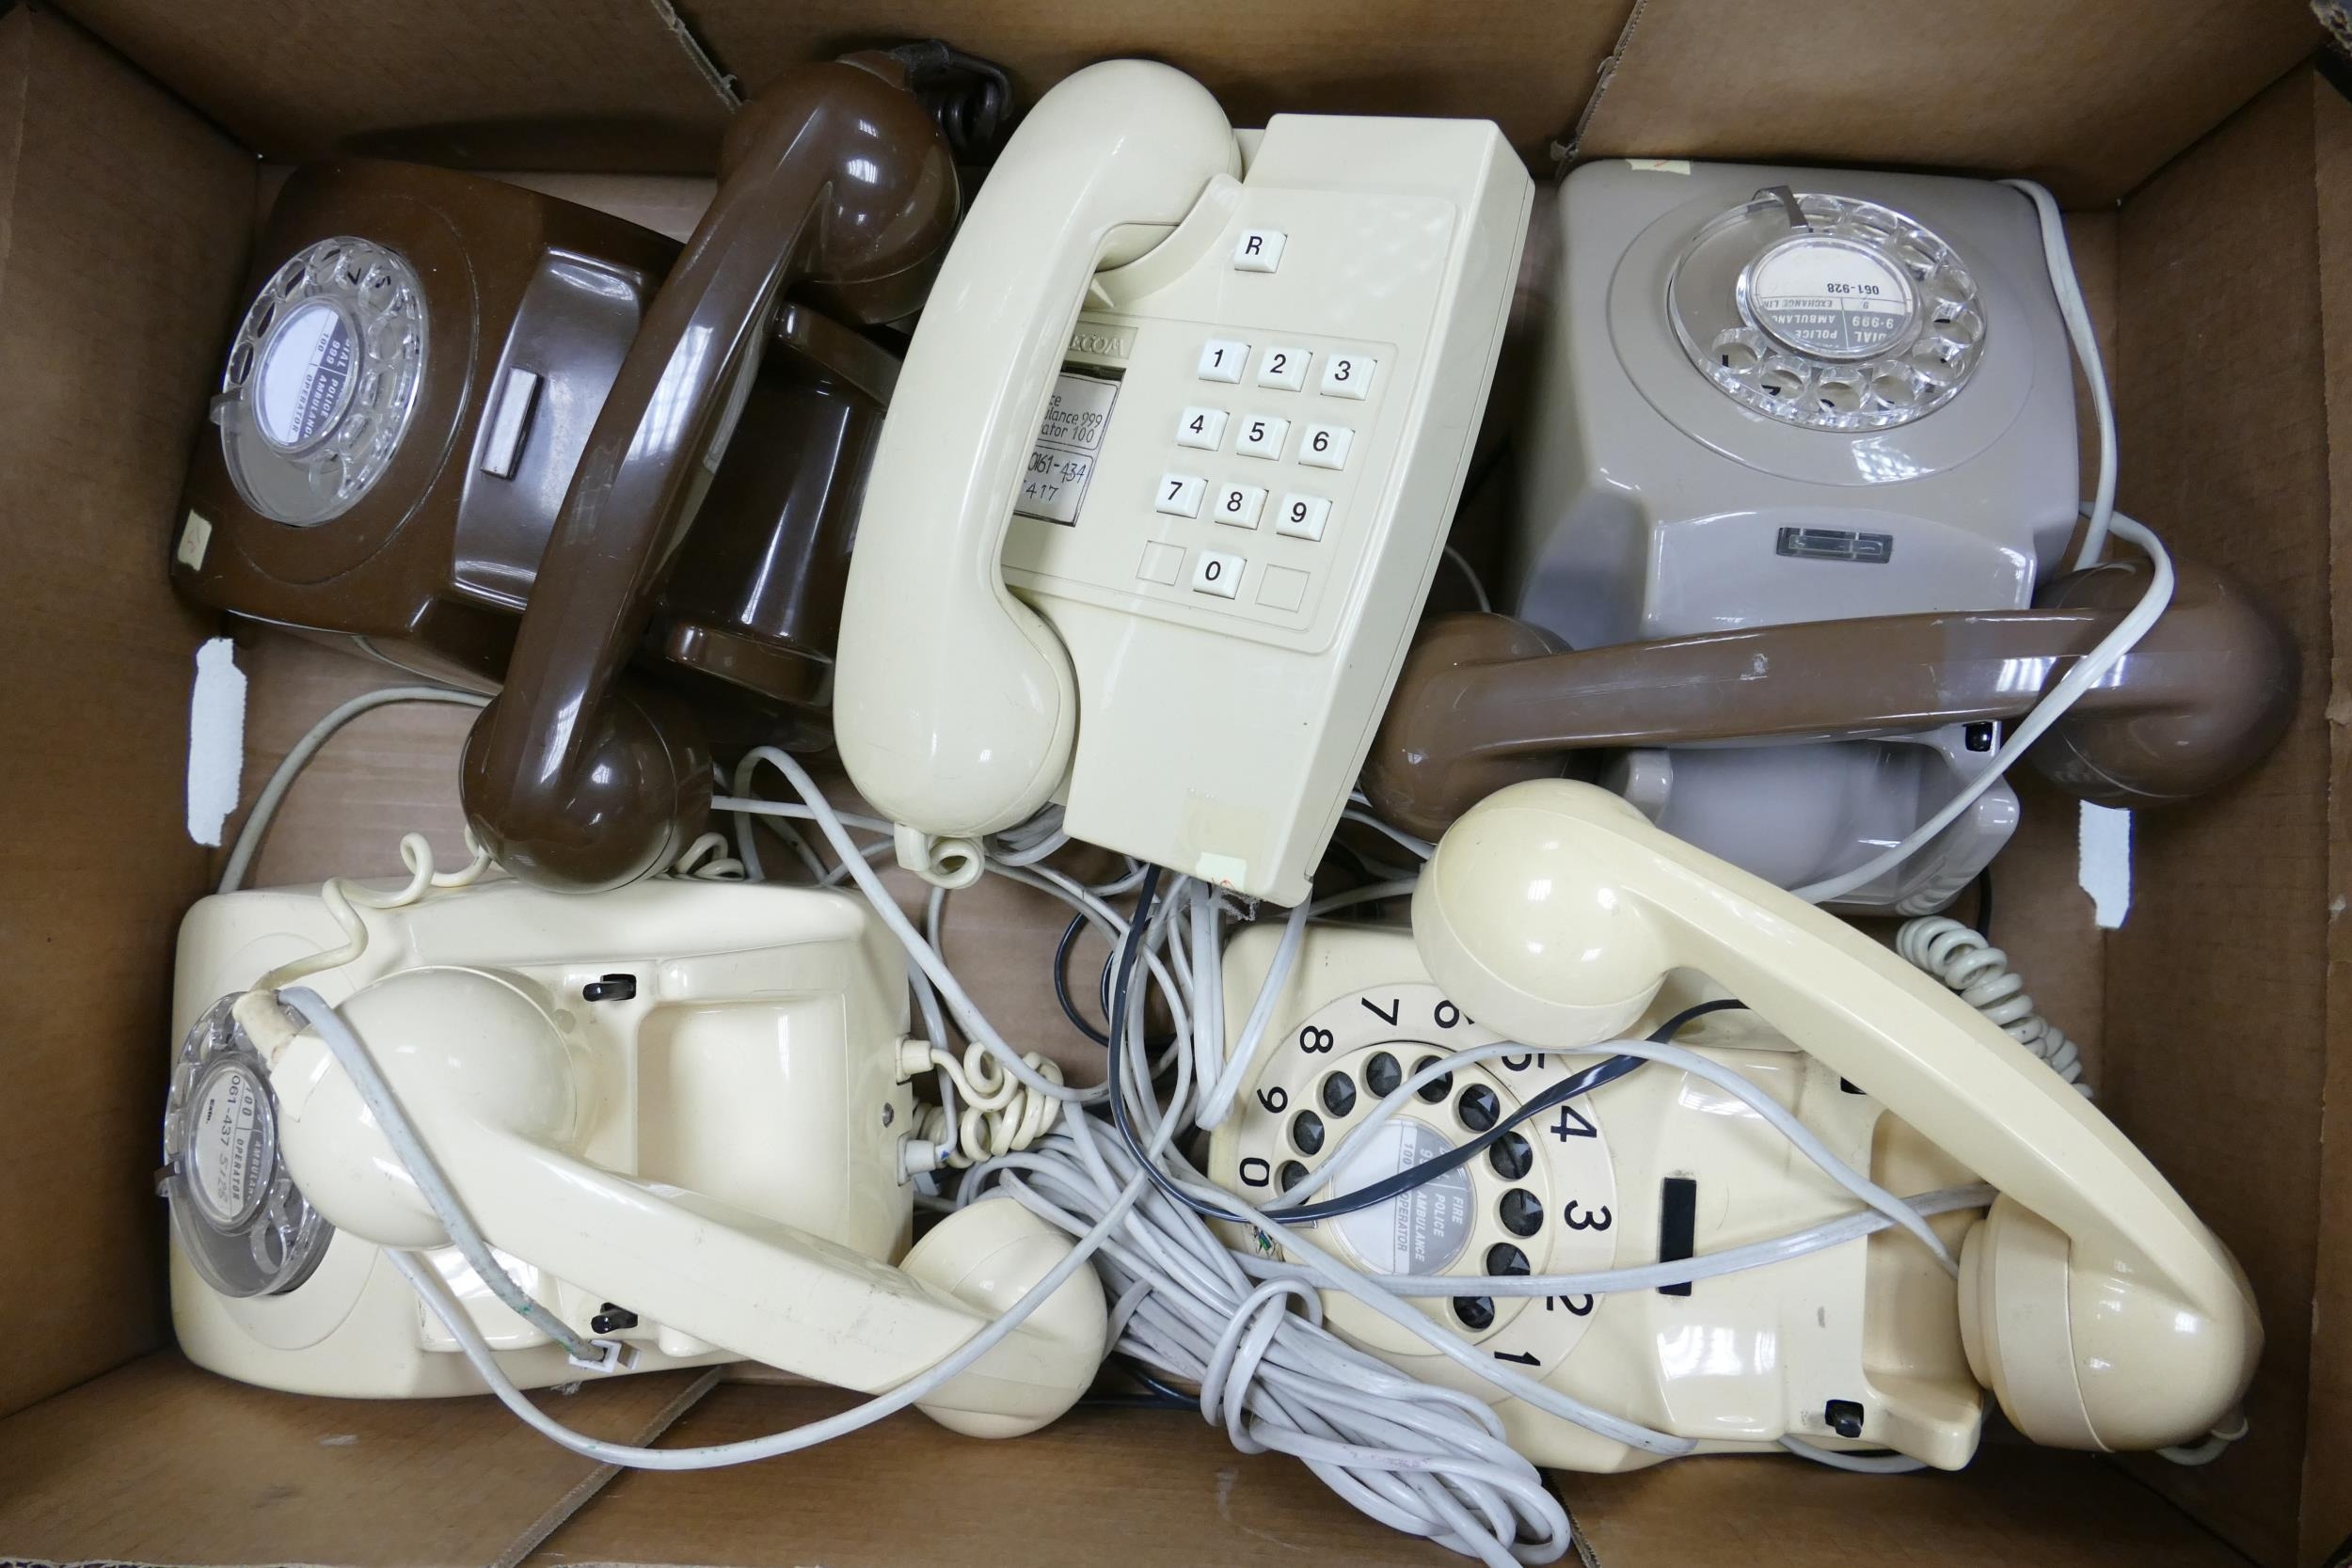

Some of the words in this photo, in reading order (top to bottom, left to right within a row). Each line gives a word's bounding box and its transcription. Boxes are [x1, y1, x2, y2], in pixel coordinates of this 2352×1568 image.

[1245, 235, 1263, 256] R
[1827, 282, 1880, 295] 061-928
[1782, 298, 1834, 309] EXCHANGE
[318, 333, 329, 353] 100
[1795, 329, 1837, 340] POLICE
[326, 341, 341, 365] 999
[1214, 348, 1225, 368] 1
[1270, 353, 1287, 374] 2
[1334, 360, 1353, 382] 3
[292, 373, 313, 433] OPERATOR
[321, 378, 339, 419] POLICE
[1082, 411, 1103, 429] 999
[1189, 415, 1205, 435] 4
[1072, 426, 1095, 443] 100
[1248, 422, 1264, 443] 5
[1312, 431, 1330, 452] 6
[1167, 482, 1183, 500] 7
[1227, 491, 1244, 513] 8
[1290, 501, 1308, 524] 9
[1205, 561, 1222, 581] 0
[1361, 997, 1400, 1026] 7
[1299, 1025, 1334, 1053] 8
[219, 1074, 241, 1147] 061-437
[1257, 1085, 1289, 1114] 9
[1550, 1105, 1597, 1143] 4
[1402, 1143, 1413, 1165] 100
[232, 1137, 245, 1200] OPERATOR
[1239, 1157, 1270, 1187] 0
[1397, 1191, 1410, 1252] OPERATOR
[1434, 1193, 1446, 1238] POLICE
[1452, 1196, 1464, 1225] FIRE
[1565, 1199, 1613, 1232] 3
[1415, 1190, 1427, 1262] AMBULANCE
[1494, 1351, 1541, 1367] 1
